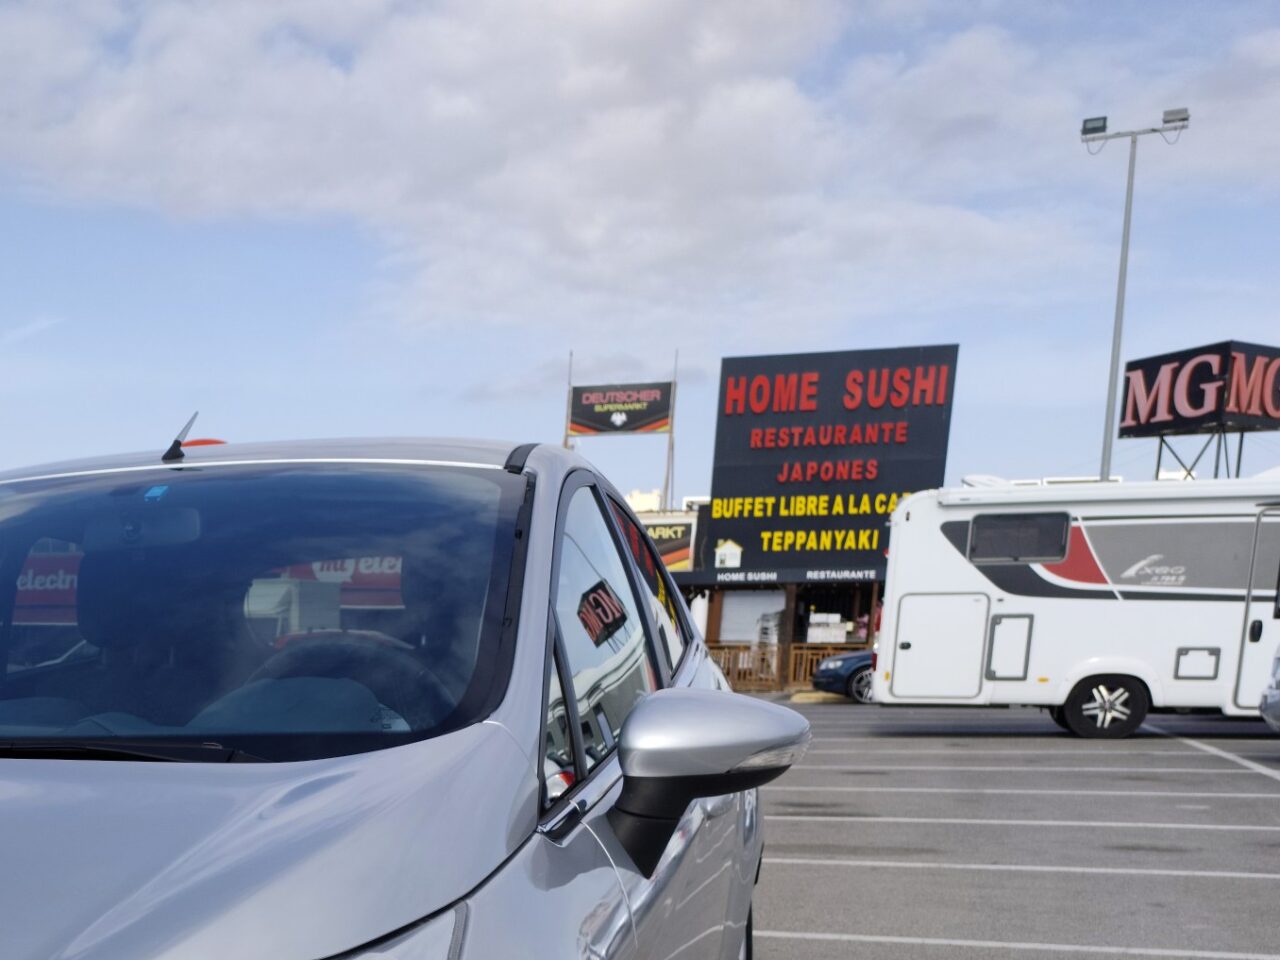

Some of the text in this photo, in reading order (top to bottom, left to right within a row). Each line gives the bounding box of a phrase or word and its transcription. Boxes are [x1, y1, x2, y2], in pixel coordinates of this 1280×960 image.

[582, 389, 661, 404] DEUTSCHER
[724, 365, 949, 414] HOME SUSHI
[1120, 354, 1224, 427] MG
[593, 401, 649, 412] SUPERMARKT
[750, 422, 908, 449] RESTAURANTE
[776, 459, 879, 482] JAPONES
[711, 492, 912, 518] BUFFET LIBRE A LA CA
[760, 529, 879, 551] TEPPANYAKI
[717, 570, 876, 582] HOME SUSHI RESTAURANTE
